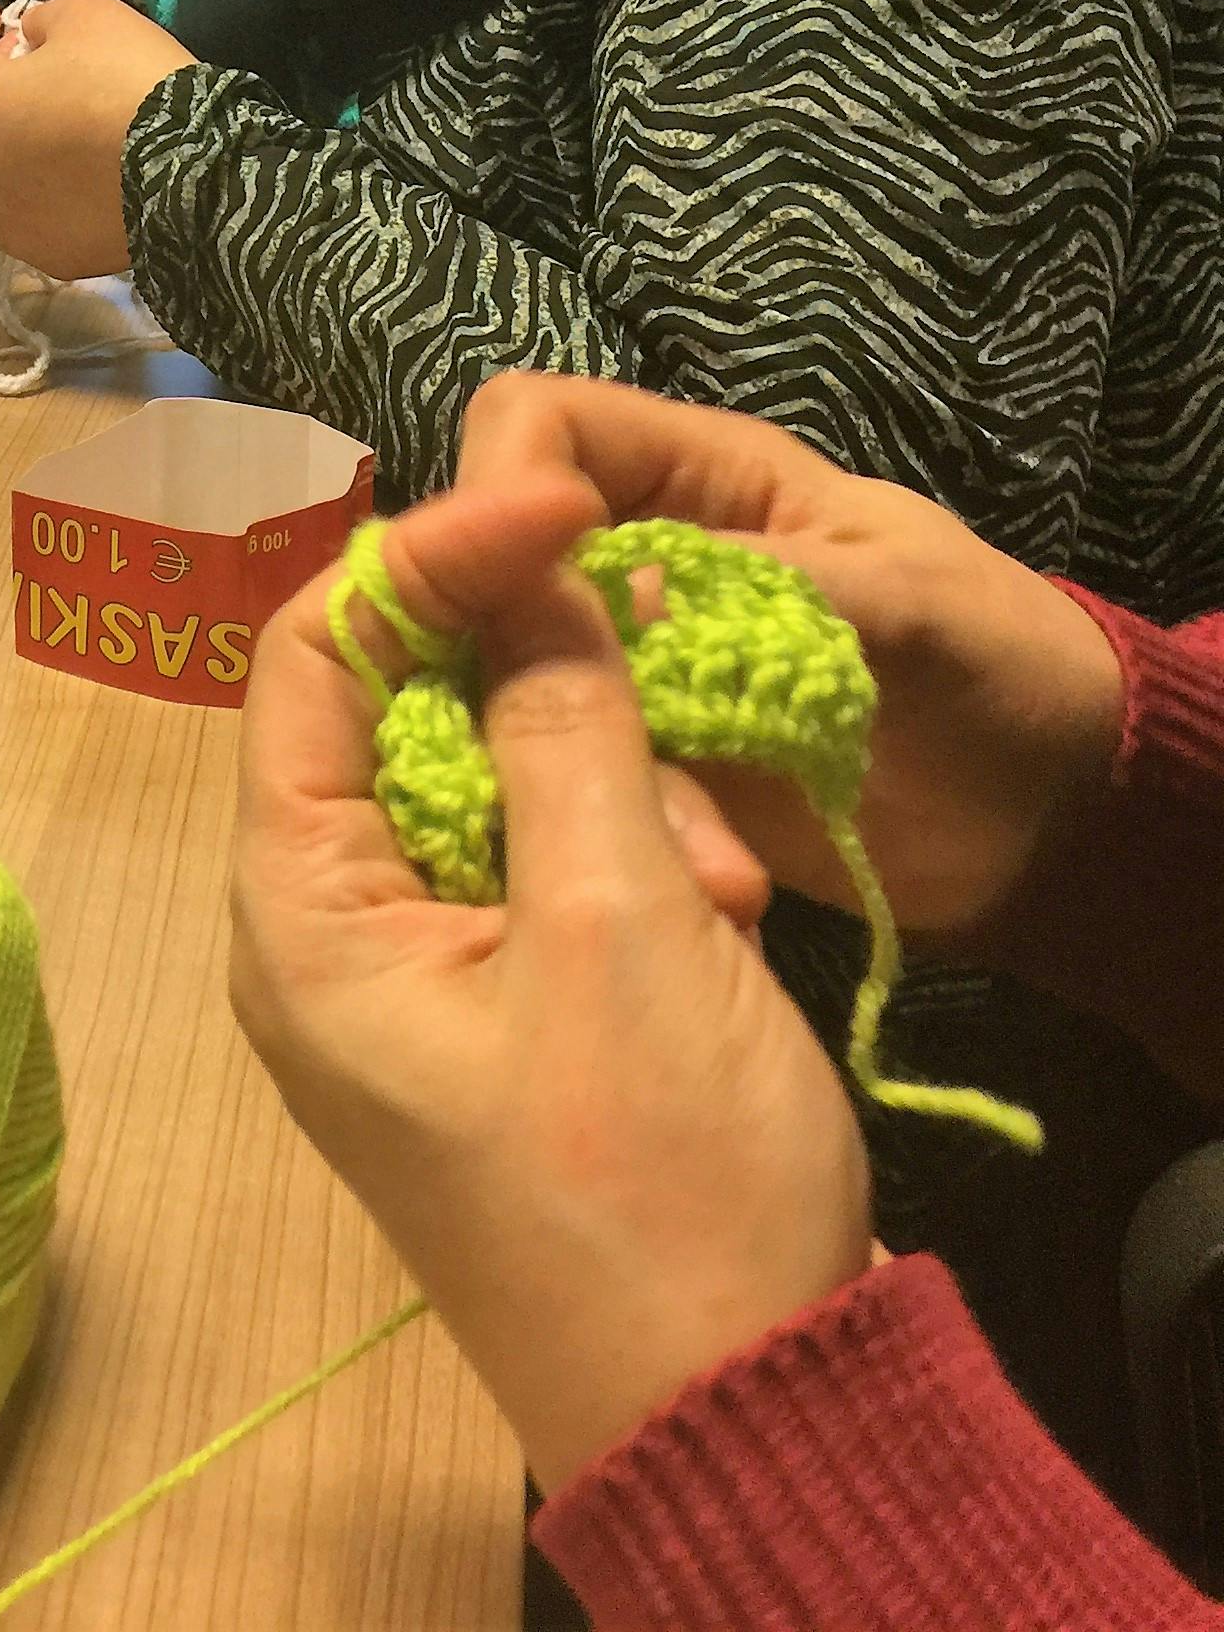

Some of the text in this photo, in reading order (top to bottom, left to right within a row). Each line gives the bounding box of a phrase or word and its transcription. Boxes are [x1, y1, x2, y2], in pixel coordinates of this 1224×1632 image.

[31, 510, 192, 583] € 1.00
[247, 529, 292, 556] 100 g
[12, 571, 253, 684] SASKI
